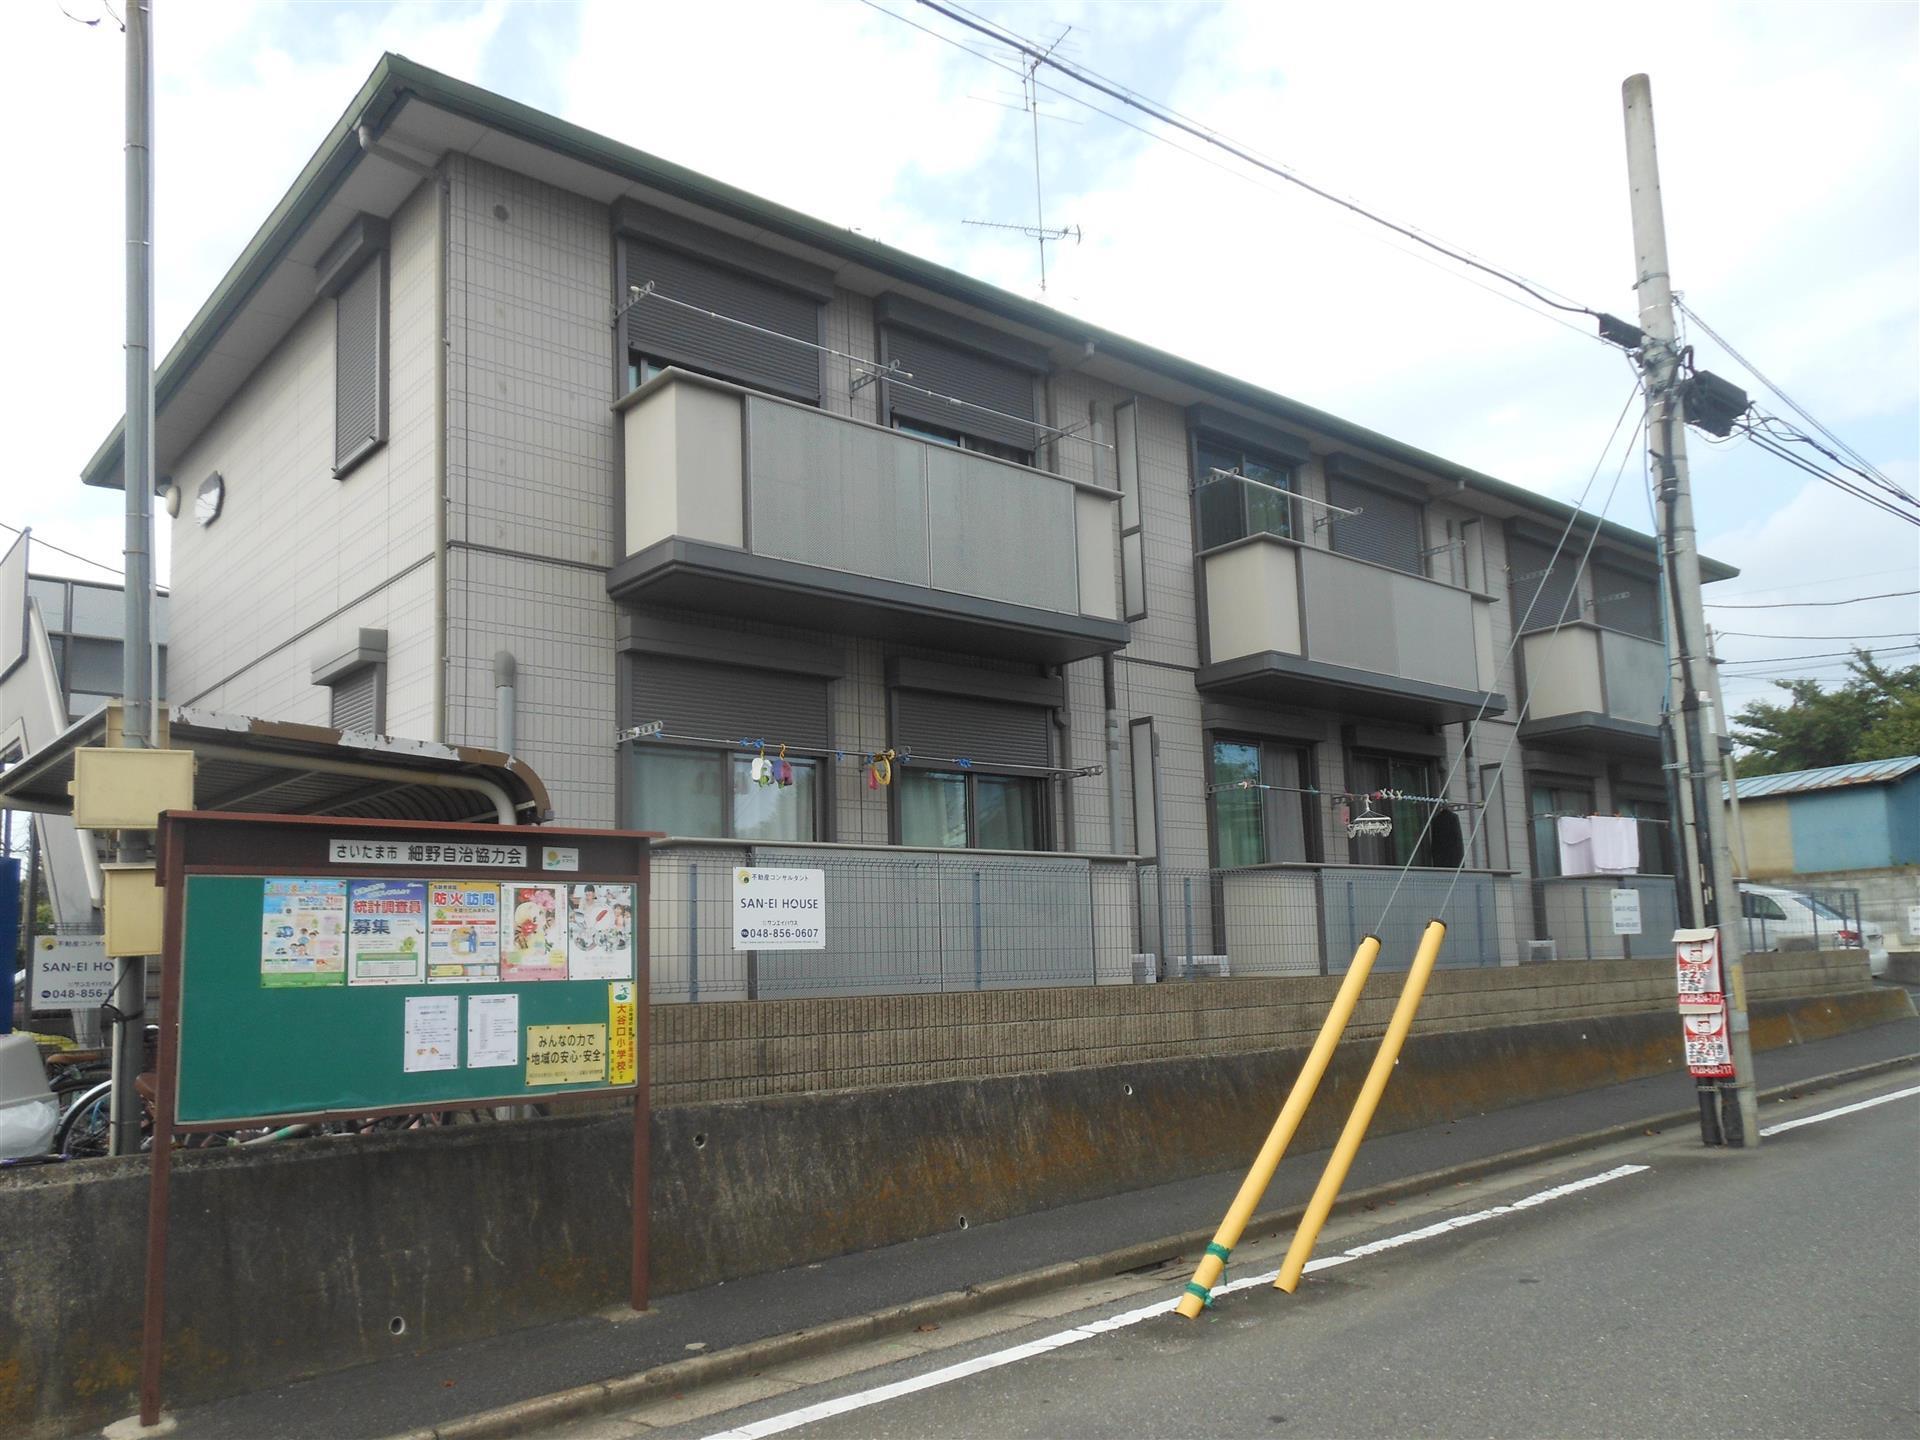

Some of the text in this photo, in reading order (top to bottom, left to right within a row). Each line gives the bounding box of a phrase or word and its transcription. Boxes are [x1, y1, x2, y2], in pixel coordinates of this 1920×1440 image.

[337, 844, 522, 865] さいたま市 細野自治協力会
[752, 873, 808, 881] 不動産コンサルタント
[433, 892, 495, 906] 防火訪問
[741, 898, 818, 909] SAN-EI HOUSE
[353, 900, 422, 914] 統計調査員
[352, 919, 391, 935] 募集
[750, 928, 818, 938] 048-856-0607
[42, 962, 114, 972] SAN-EI HO
[52, 989, 114, 999] 048-856-
[539, 1034, 595, 1048] みんなの力で
[531, 1049, 601, 1066] 地域の安心・安全
